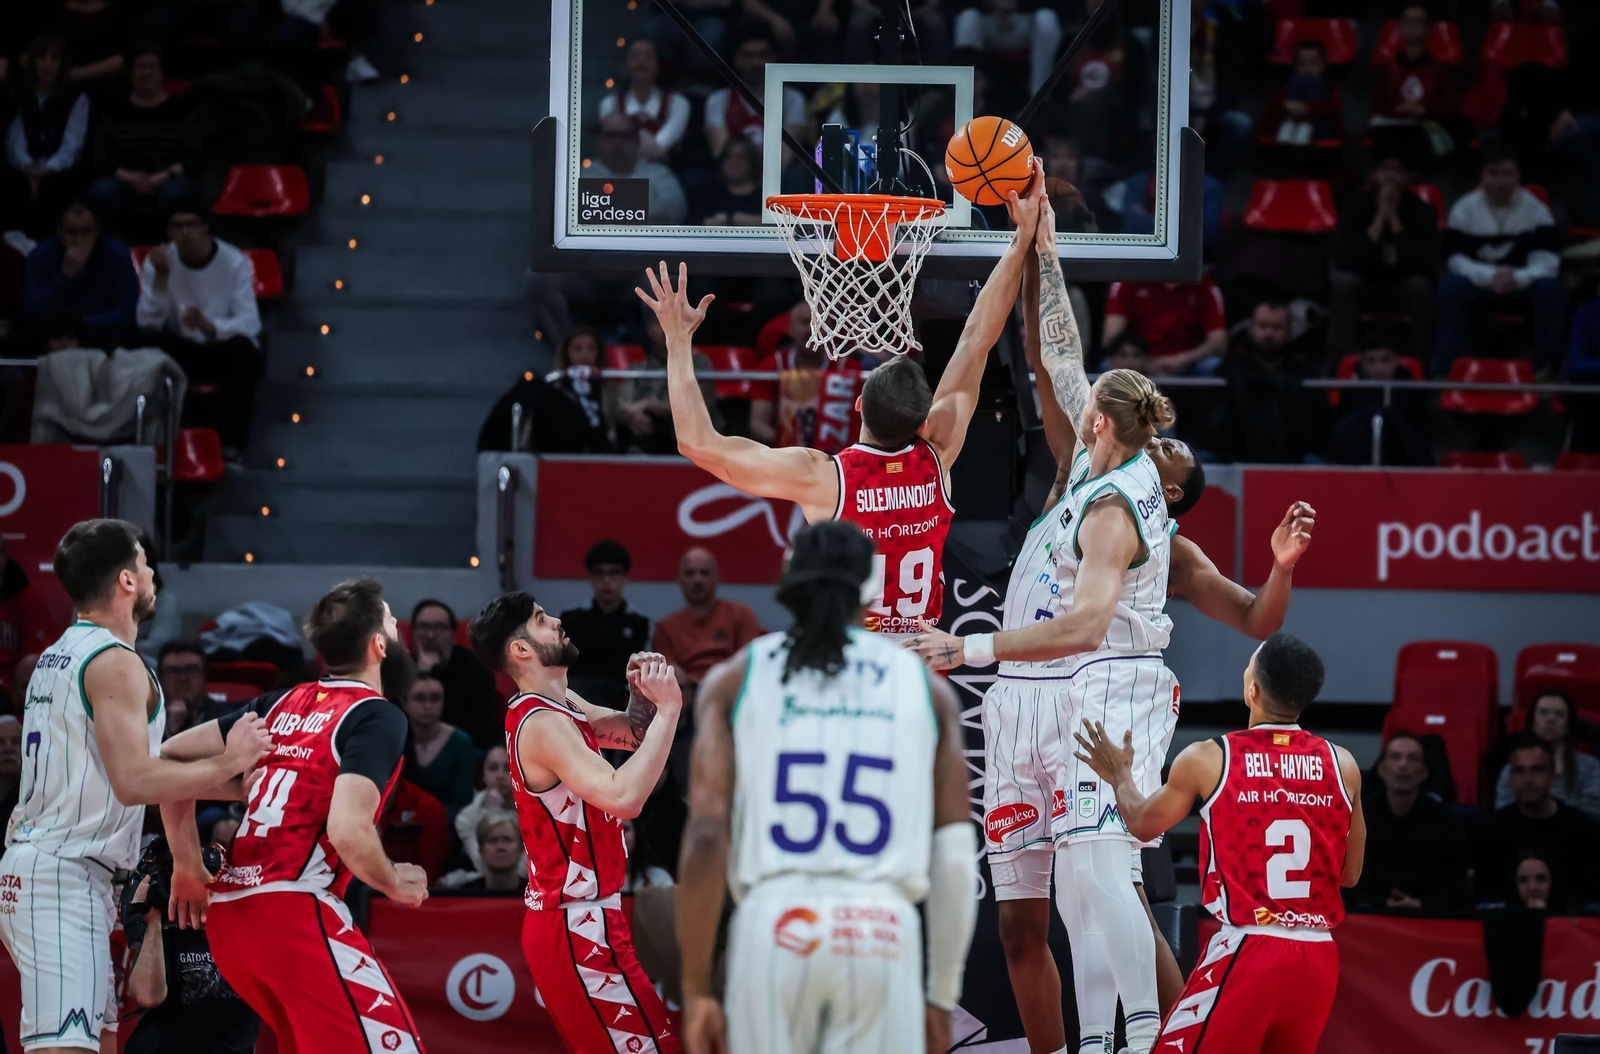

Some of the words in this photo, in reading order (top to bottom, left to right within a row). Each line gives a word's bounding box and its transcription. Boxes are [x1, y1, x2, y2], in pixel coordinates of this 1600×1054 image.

[581, 191, 611, 208] liga
[581, 206, 646, 221] endesa
[856, 476, 937, 513] SULEJMANOVIĆ
[878, 515, 940, 539] HORIZONT
[865, 546, 935, 616] 19
[36, 648, 72, 670] arreiro
[235, 765, 299, 838] 14
[770, 752, 894, 856] 55
[1237, 790, 1260, 803] AIR
[1263, 788, 1333, 808] HORIZONT
[986, 806, 1037, 837] famadesa
[1265, 819, 1311, 899] 2
[0, 874, 22, 890] STA
[1, 890, 19, 903] SOL
[1410, 957, 1600, 1020] Caad
